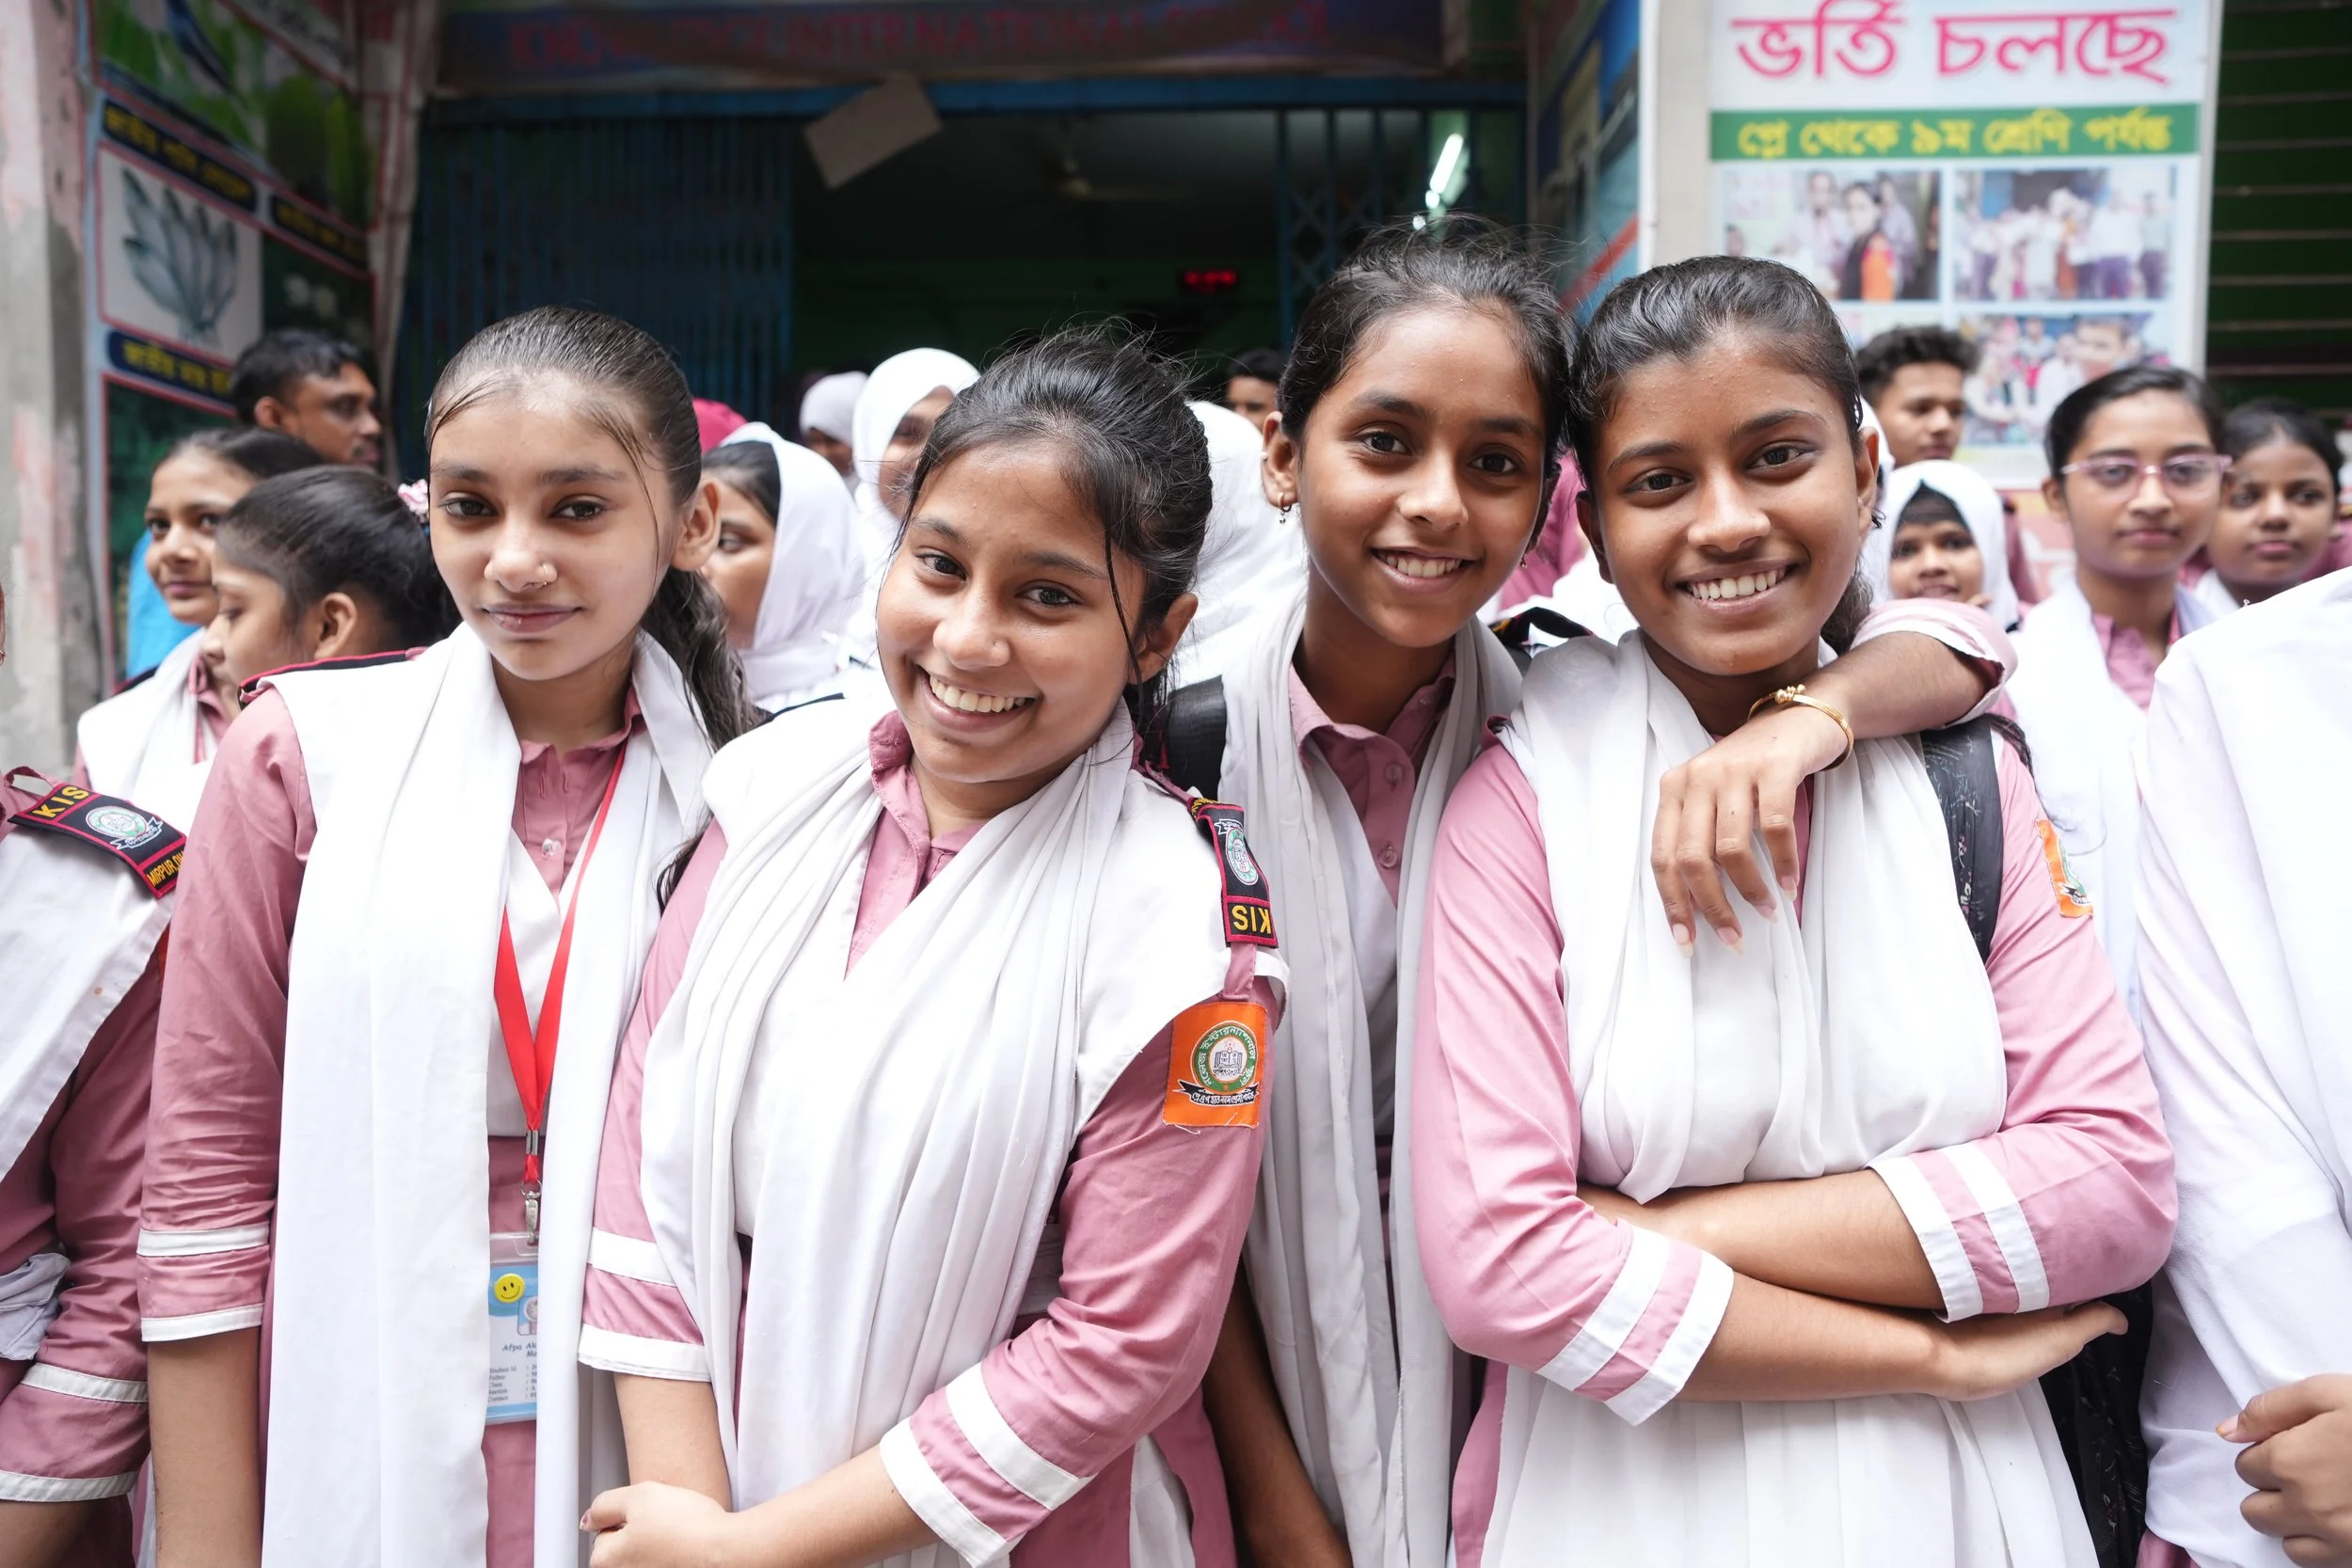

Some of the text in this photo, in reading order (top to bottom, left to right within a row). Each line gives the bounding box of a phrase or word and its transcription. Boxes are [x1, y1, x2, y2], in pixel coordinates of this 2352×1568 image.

[1730, 0, 2177, 86] ভর্তি চলছে
[1799, 119, 1901, 156] থেকে
[32, 784, 90, 818] KIS
[1232, 905, 1272, 934] KIS
[1199, 1052, 1213, 1086] নলেজ
